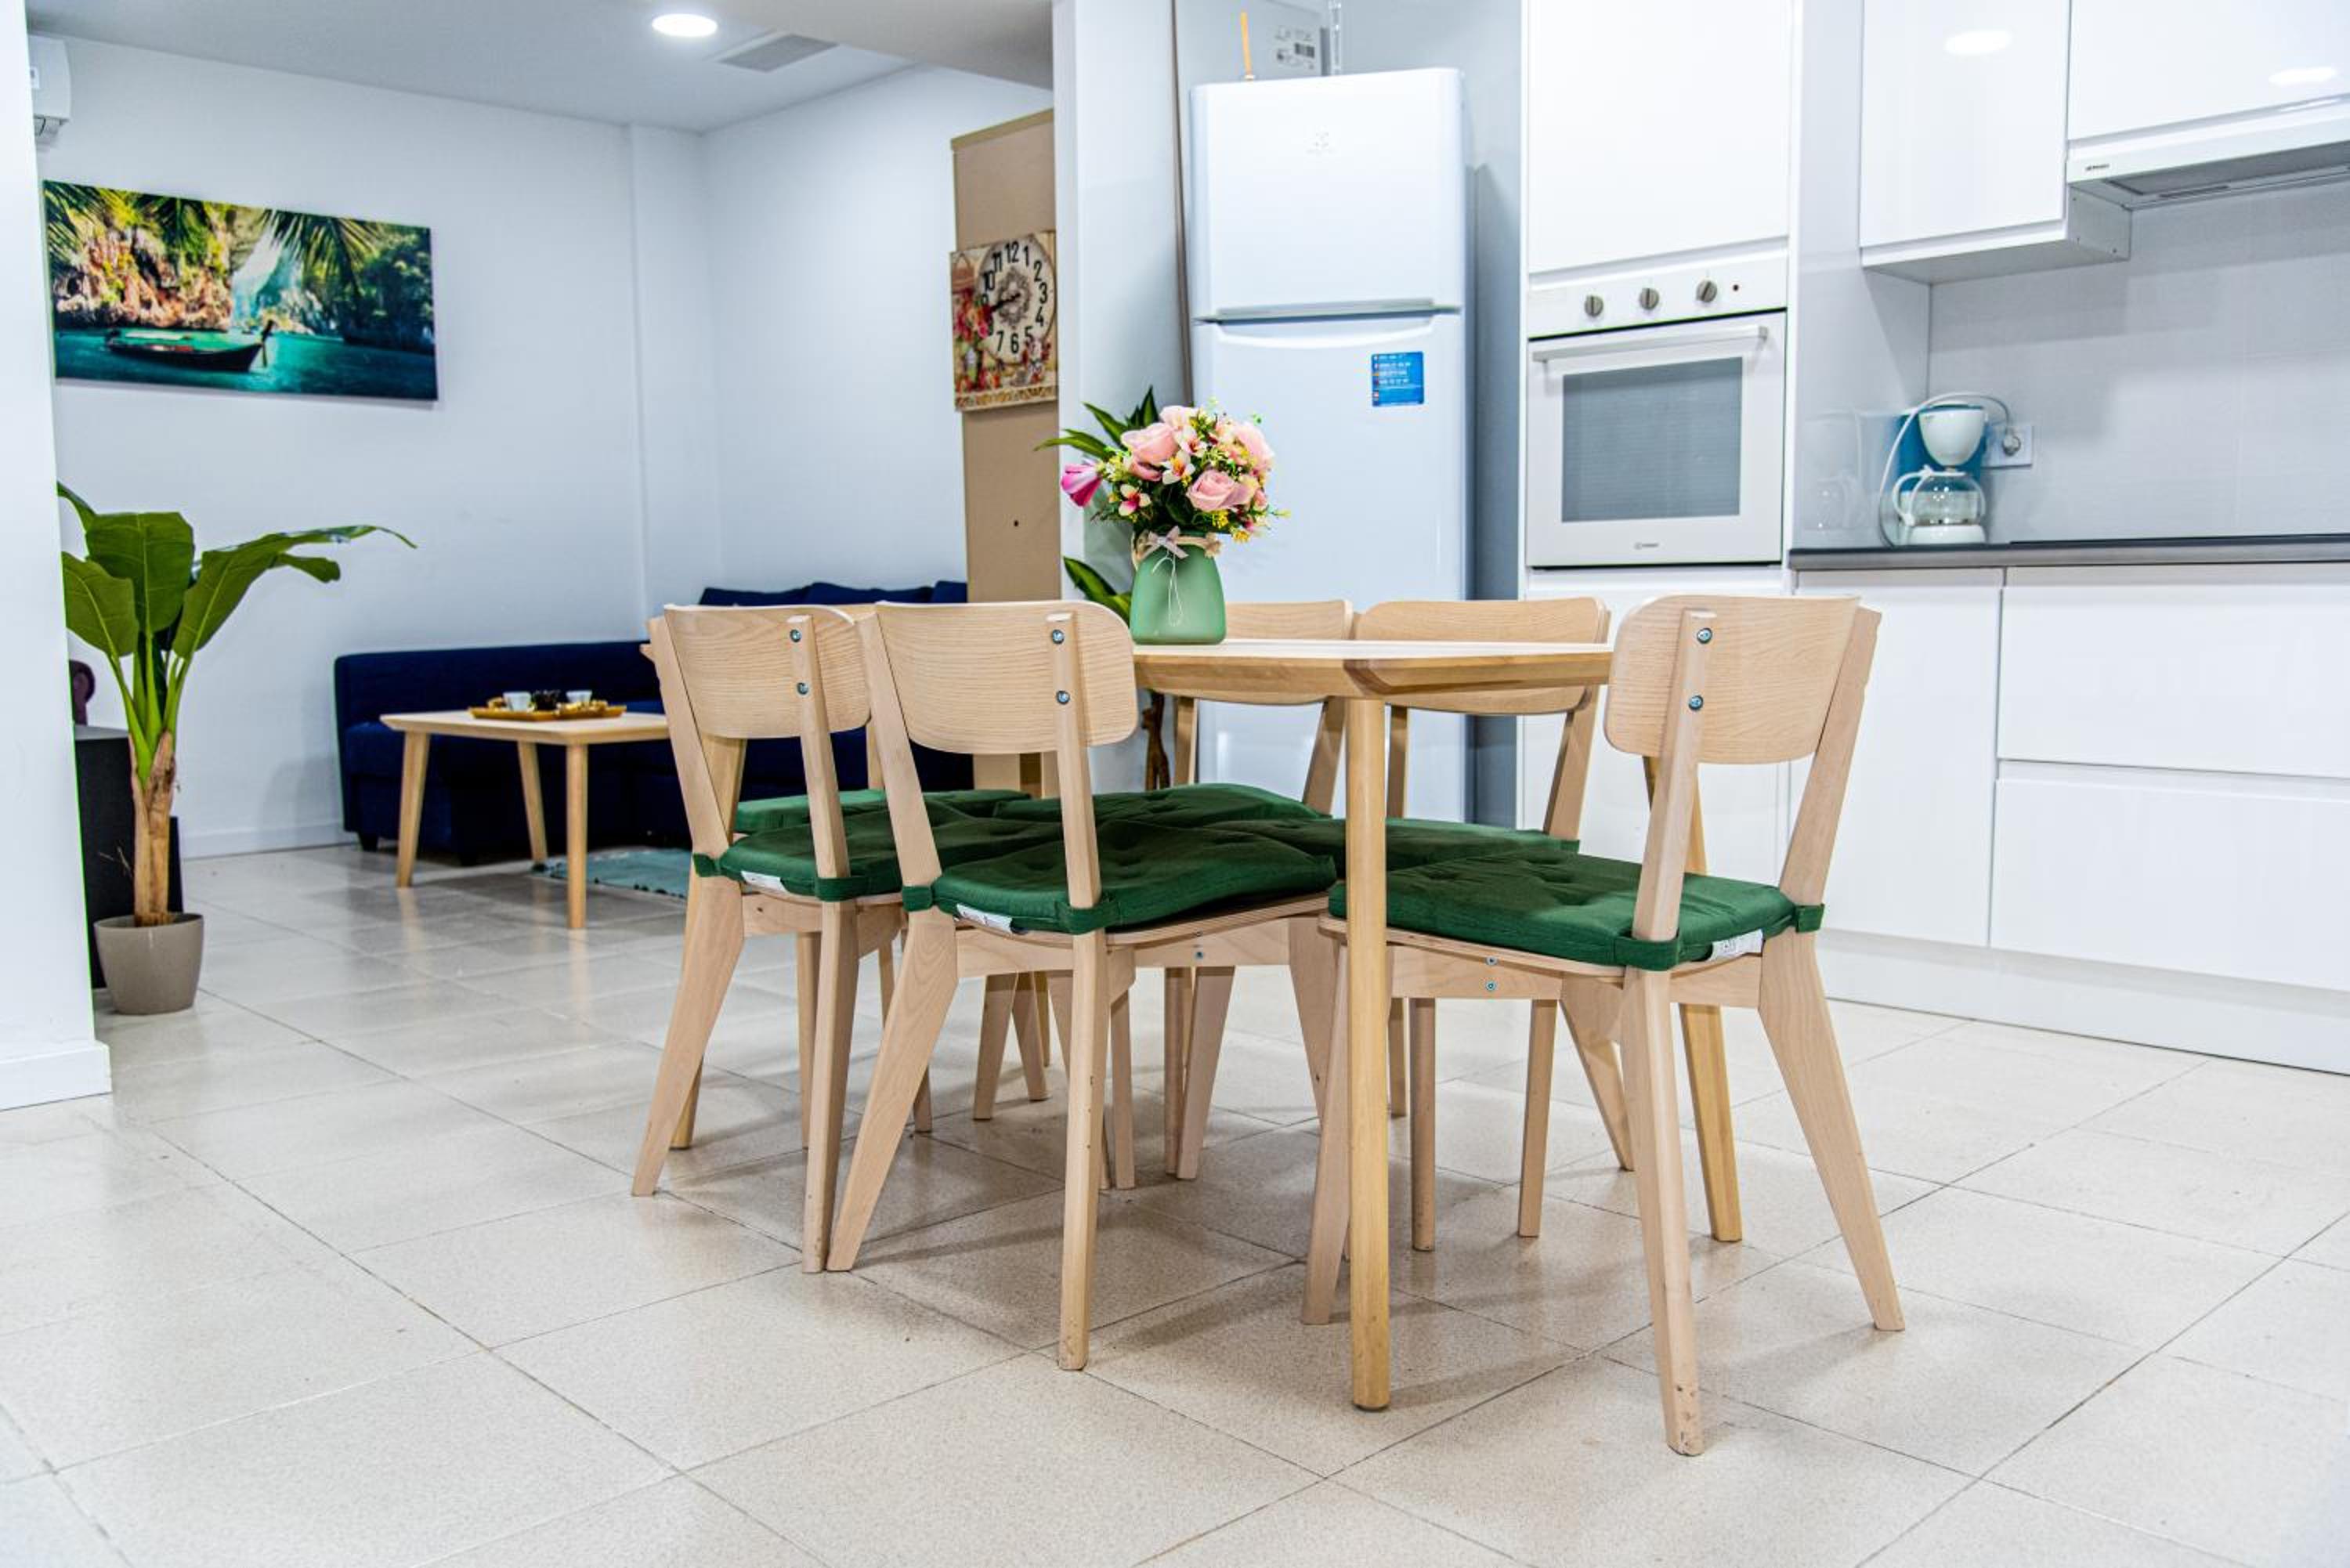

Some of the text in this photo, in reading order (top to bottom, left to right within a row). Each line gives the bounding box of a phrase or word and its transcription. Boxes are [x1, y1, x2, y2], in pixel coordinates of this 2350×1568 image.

[992, 251, 1002, 273] 11
[1005, 240, 1019, 263] 12
[1023, 245, 1029, 267] 1
[983, 270, 995, 291] 10
[1033, 260, 1042, 282] 2
[1039, 282, 1048, 304] 3
[1036, 306, 1044, 327] 4
[996, 330, 1004, 352] 7
[1010, 333, 1019, 354] 6
[1025, 326, 1035, 343] 5
